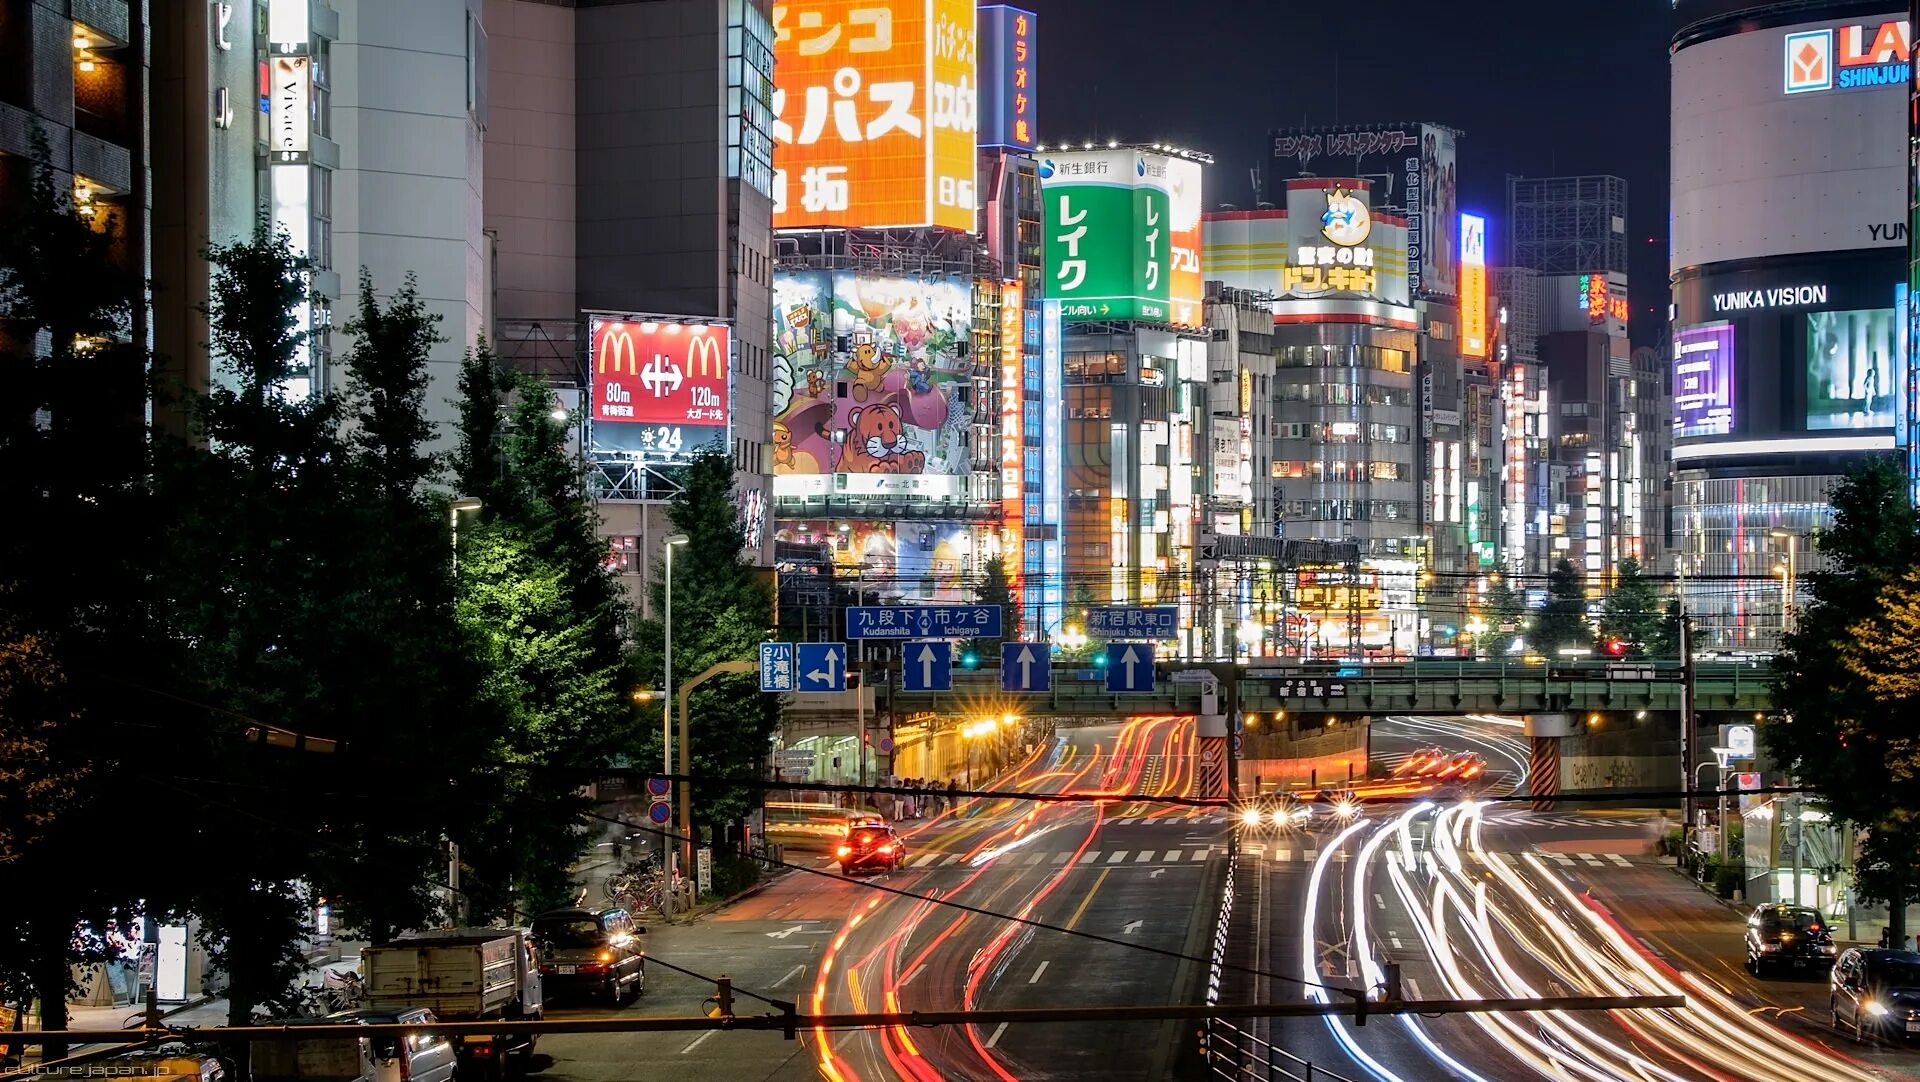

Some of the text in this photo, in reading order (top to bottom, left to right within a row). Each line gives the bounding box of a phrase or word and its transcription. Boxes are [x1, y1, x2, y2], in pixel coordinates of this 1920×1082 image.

[1016, 15, 1029, 143] カラオケ館
[281, 82, 297, 147] Vivace
[1326, 131, 1418, 155] レストランタワー
[1059, 161, 1108, 176] 新生銀行
[1057, 195, 1088, 291] レイク
[1145, 195, 1159, 291] レイク
[1170, 246, 1200, 273] アコム
[1713, 285, 1827, 312] YUNIKA VISION
[606, 383, 630, 403] 80m
[691, 387, 720, 407] 120m
[686, 409, 723, 420] 大ガード先
[658, 427, 682, 449] 24
[859, 609, 914, 626] 九段下
[1091, 610, 1171, 626] 新宿駅東口
[863, 627, 911, 636] Kudanshita
[944, 626, 980, 636] Ichigaya
[1092, 628, 1126, 637] Shinjuku
[1128, 628, 1143, 636] Sta.
[1146, 628, 1154, 636] E.
[763, 647, 772, 688] Otakibashi
[774, 645, 790, 689] 小滝橋
[1279, 686, 1324, 697] 新宿駅
